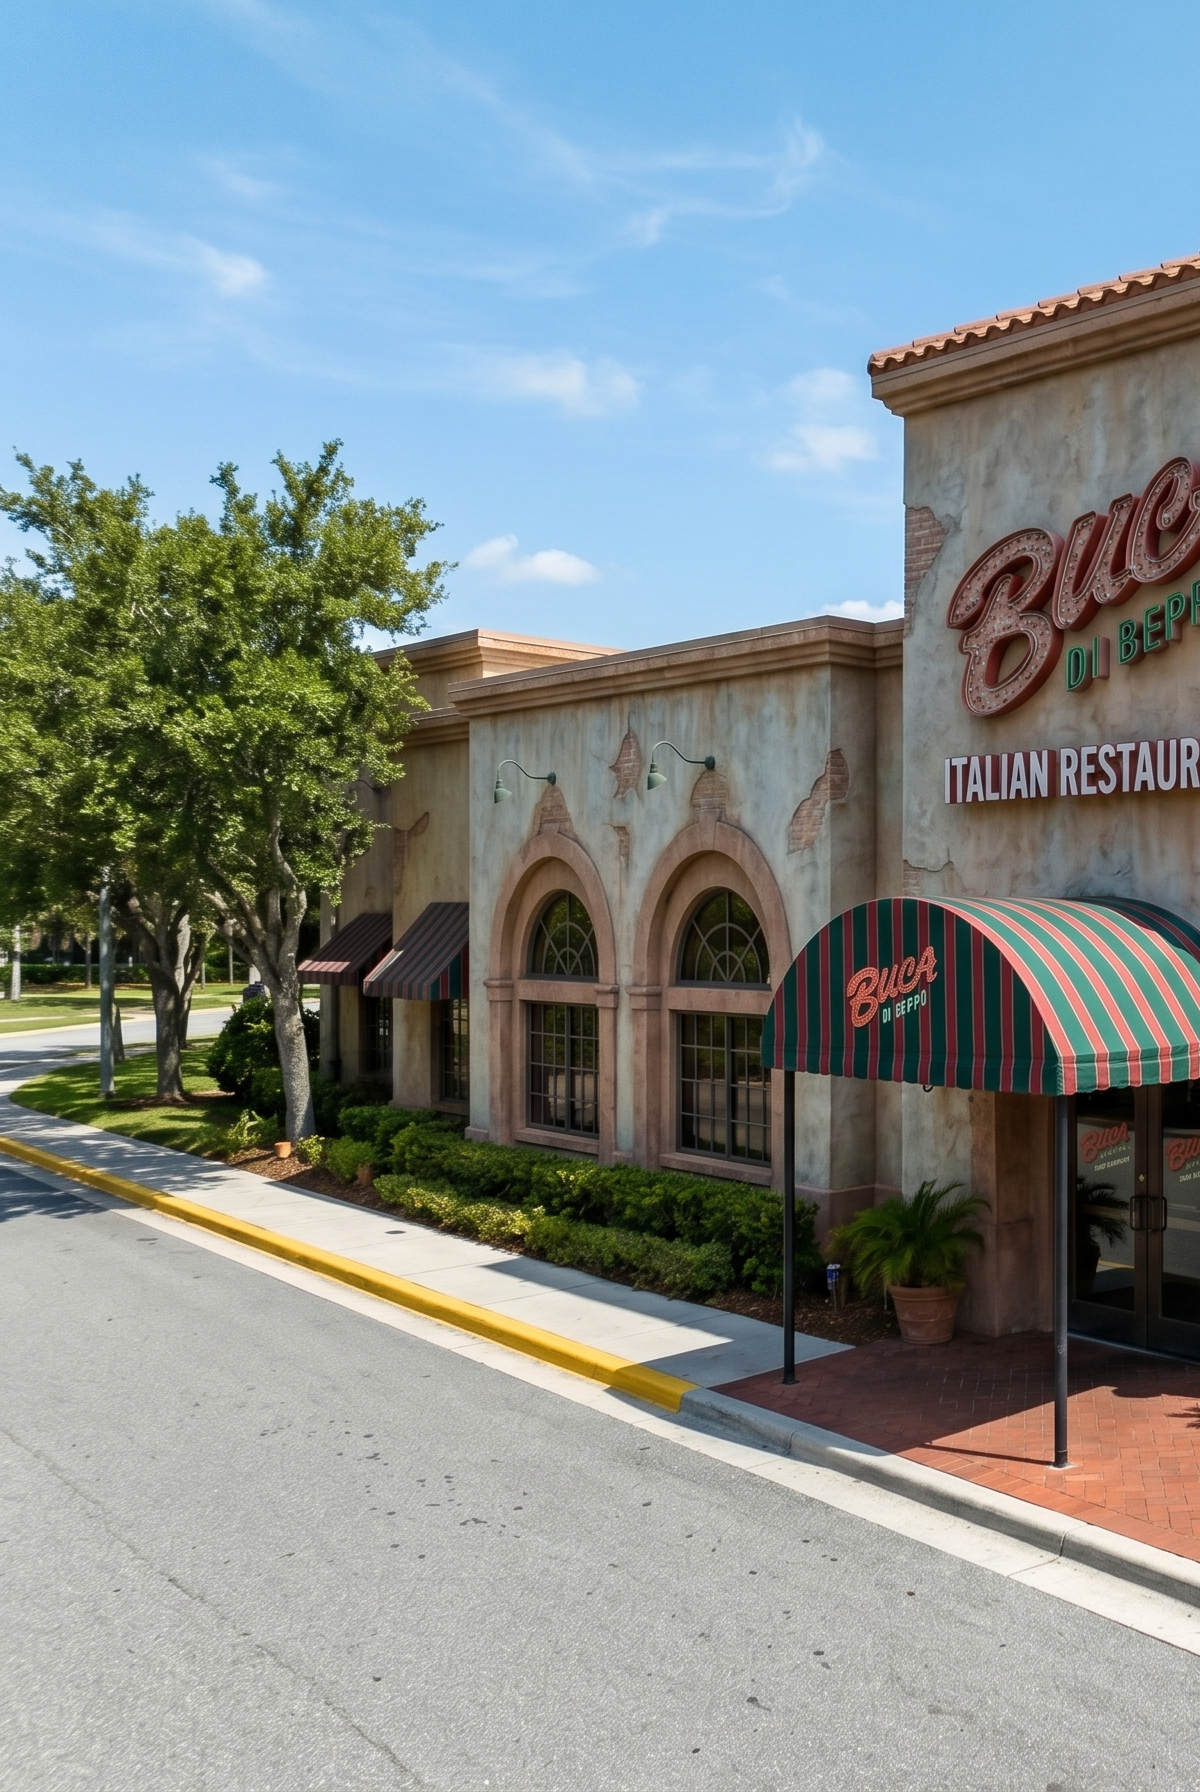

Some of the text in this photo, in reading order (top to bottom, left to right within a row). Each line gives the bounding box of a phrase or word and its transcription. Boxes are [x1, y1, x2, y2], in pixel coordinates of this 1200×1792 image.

[1066, 636, 1105, 692] DI
[945, 750, 1050, 804] ITALIAN
[847, 946, 938, 1027] BUCA
[882, 1007, 891, 1024] DI
